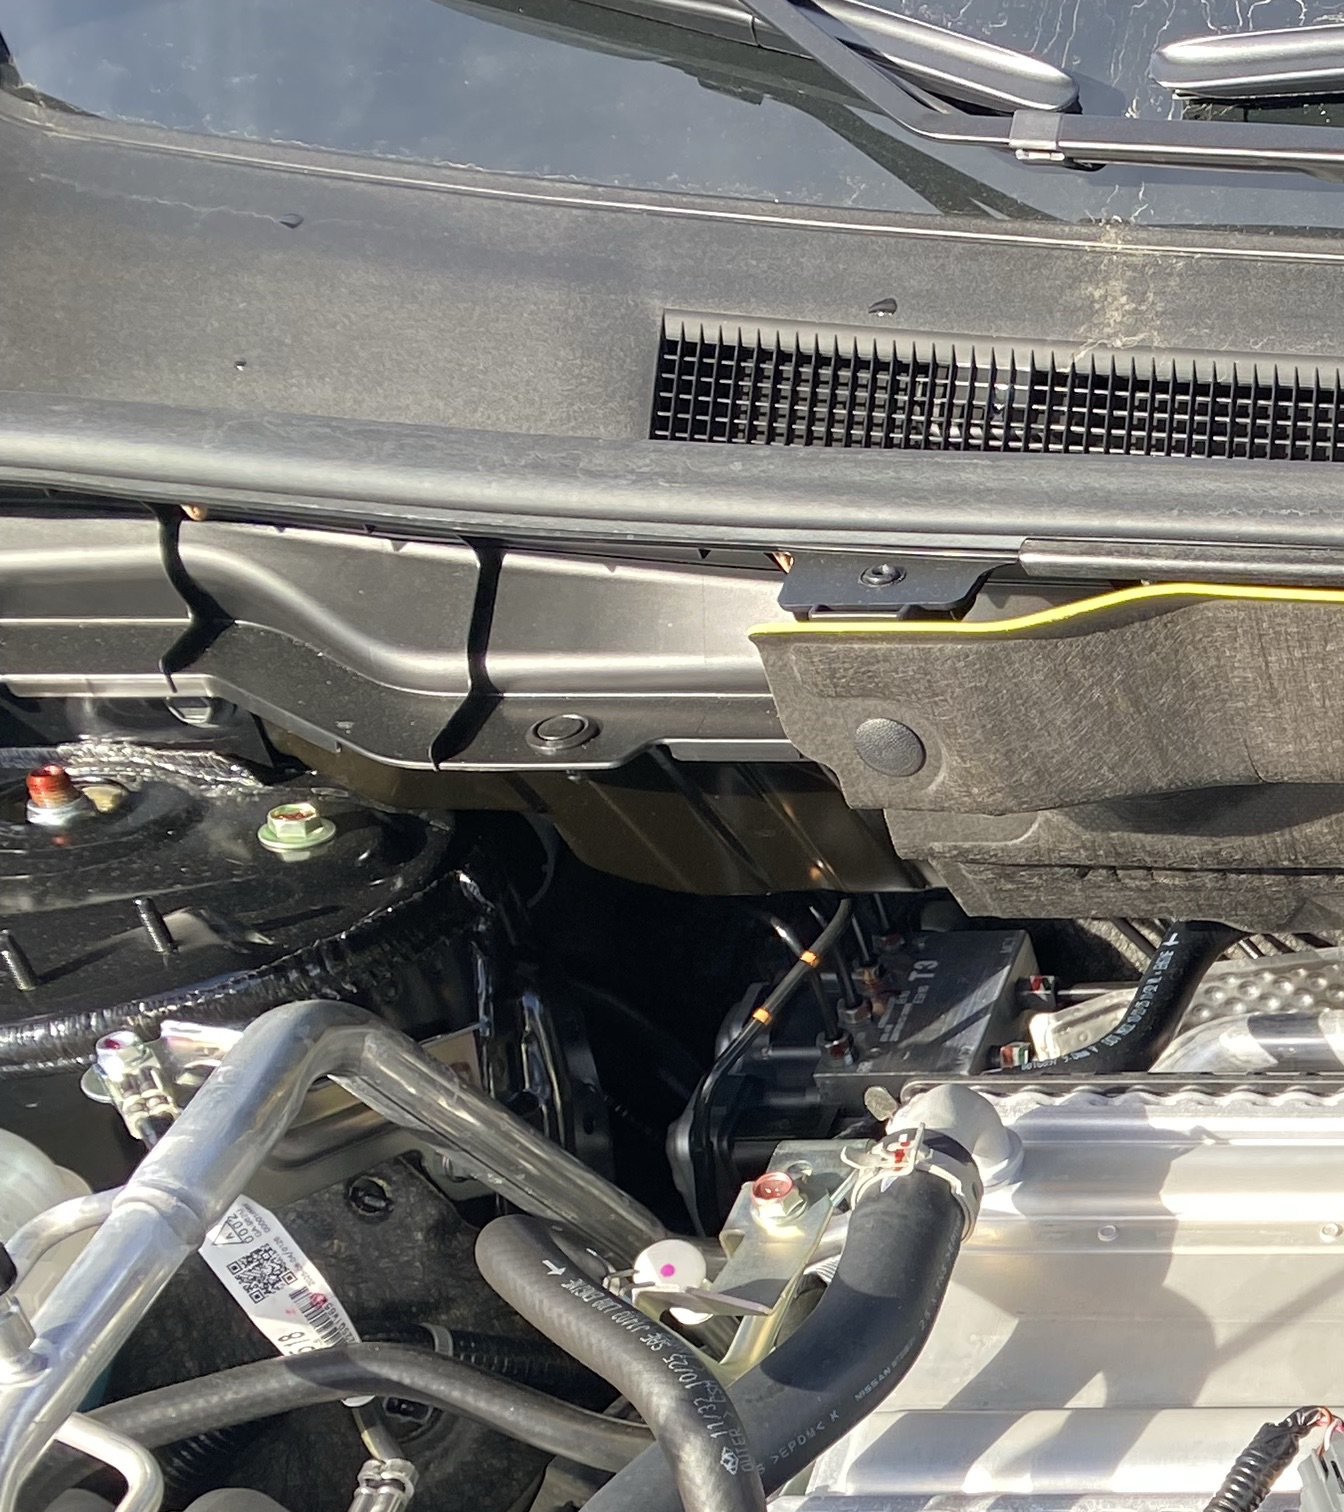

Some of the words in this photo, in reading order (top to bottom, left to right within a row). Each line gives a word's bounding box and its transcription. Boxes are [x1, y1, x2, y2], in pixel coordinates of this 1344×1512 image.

[908, 960, 939, 982] T3
[226, 1213, 254, 1244] 0002
[661, 1352, 701, 1390] 10/25
[854, 1366, 892, 1402] NISSAN
